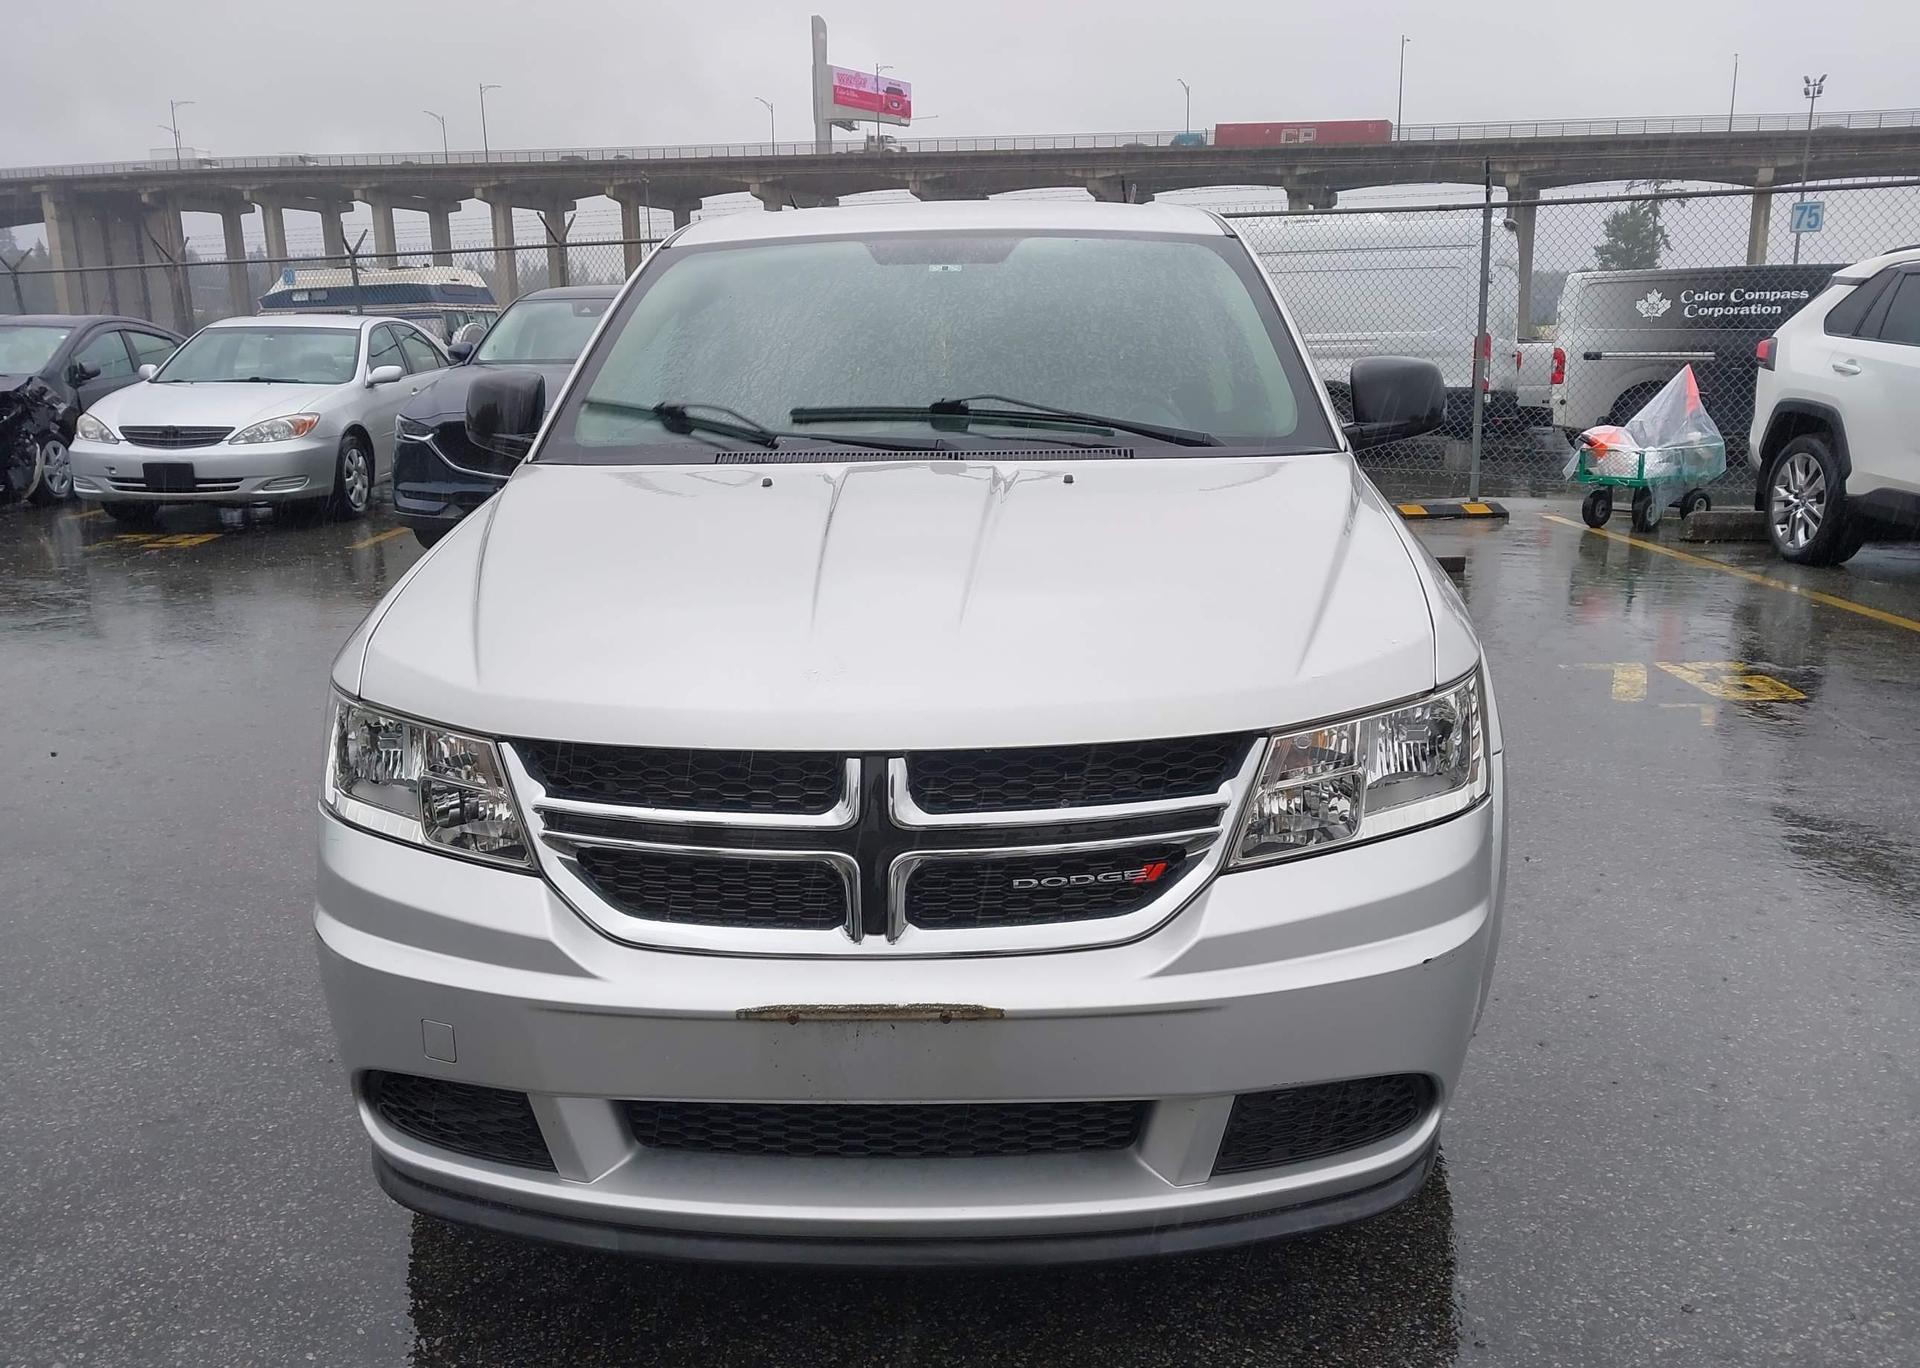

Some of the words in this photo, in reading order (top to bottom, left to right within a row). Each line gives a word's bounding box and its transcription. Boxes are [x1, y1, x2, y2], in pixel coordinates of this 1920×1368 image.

[1795, 205, 1820, 229] 75
[1680, 289, 1725, 303] Color
[1730, 288, 1809, 302] Compass
[1684, 304, 1781, 318] Corporation
[1012, 868, 1147, 889] DODGE
